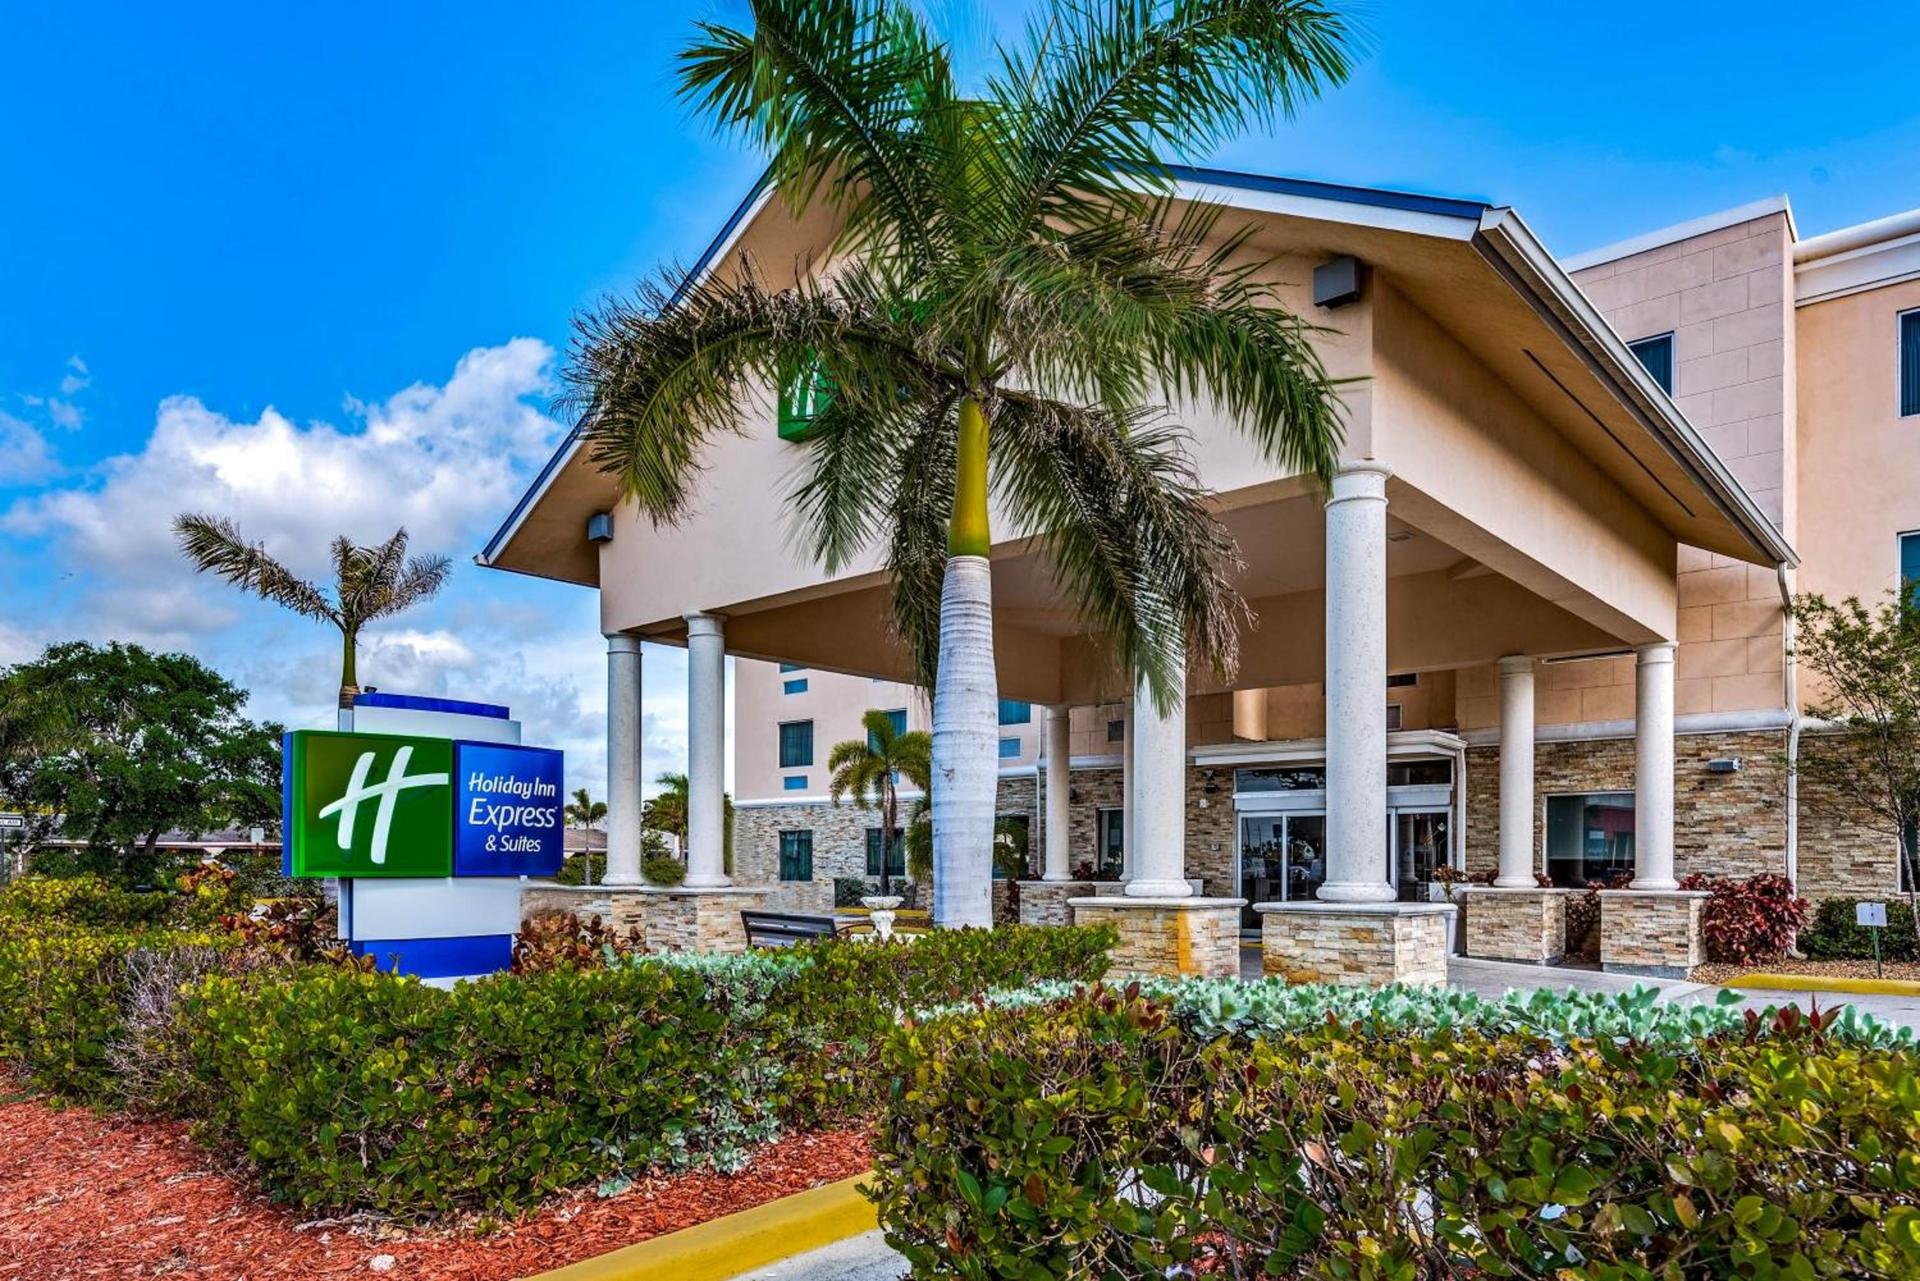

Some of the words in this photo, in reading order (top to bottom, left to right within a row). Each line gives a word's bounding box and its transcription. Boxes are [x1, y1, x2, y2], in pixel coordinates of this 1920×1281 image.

[469, 772, 533, 799] Holiday
[534, 777, 555, 797] Inn
[318, 746, 449, 864] H
[469, 798, 556, 832] Express
[485, 835, 497, 852] &
[499, 835, 541, 852] Suites
